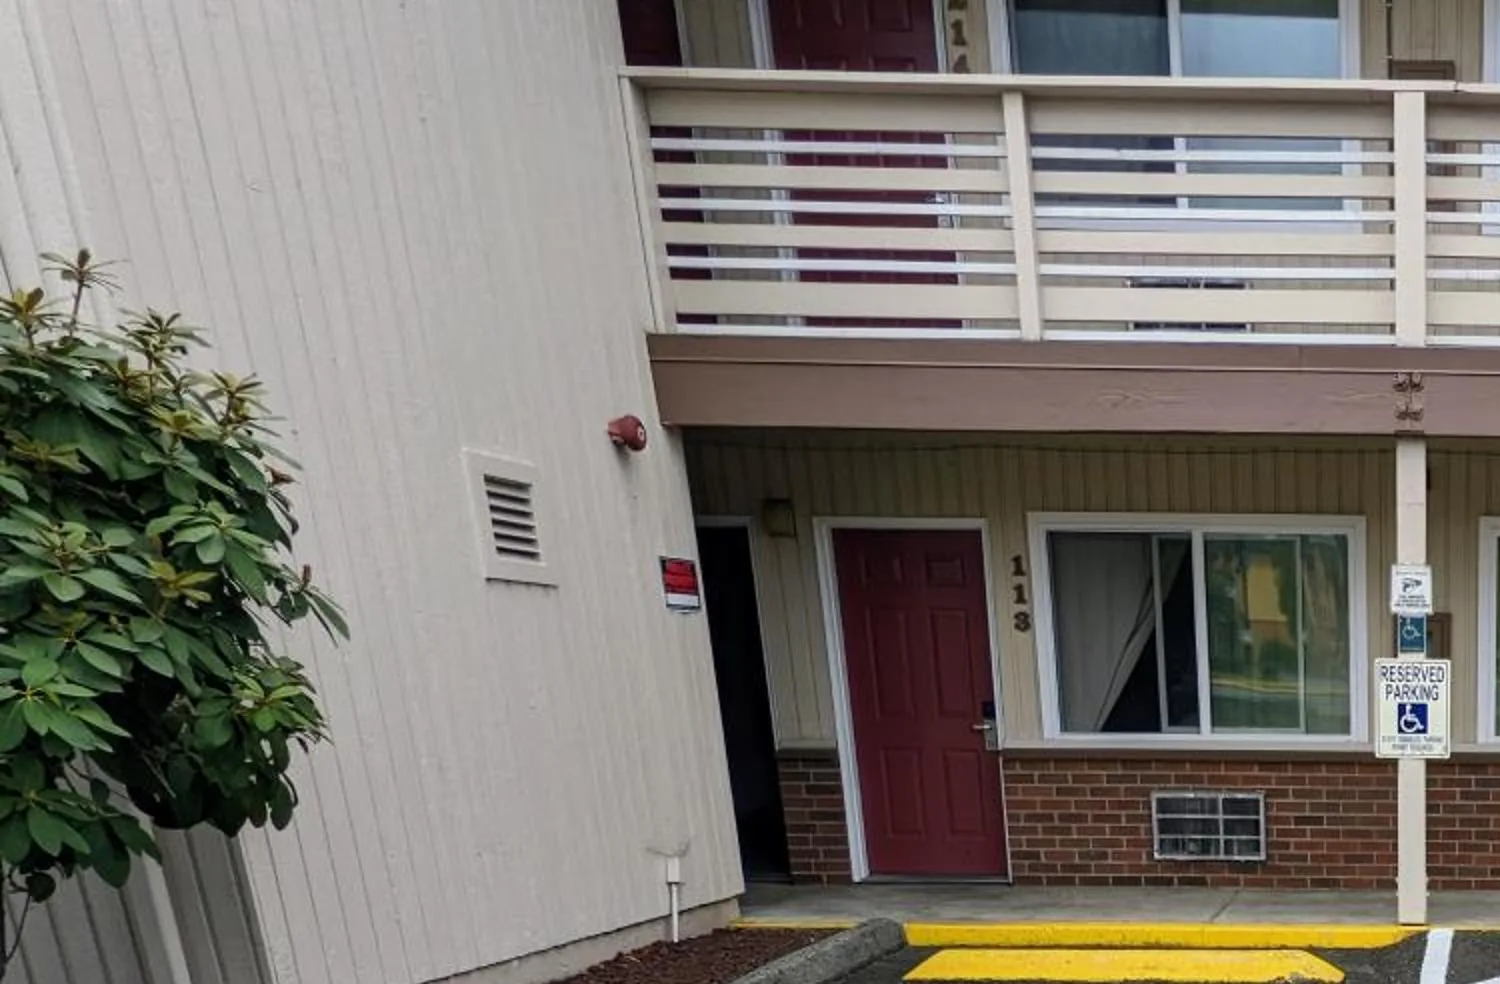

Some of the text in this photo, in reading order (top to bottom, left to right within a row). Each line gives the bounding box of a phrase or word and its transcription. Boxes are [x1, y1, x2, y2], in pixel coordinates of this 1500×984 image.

[1011, 554, 1031, 632] 113
[1380, 665, 1445, 683] RESERVED
[1385, 683, 1439, 701] PARKING
